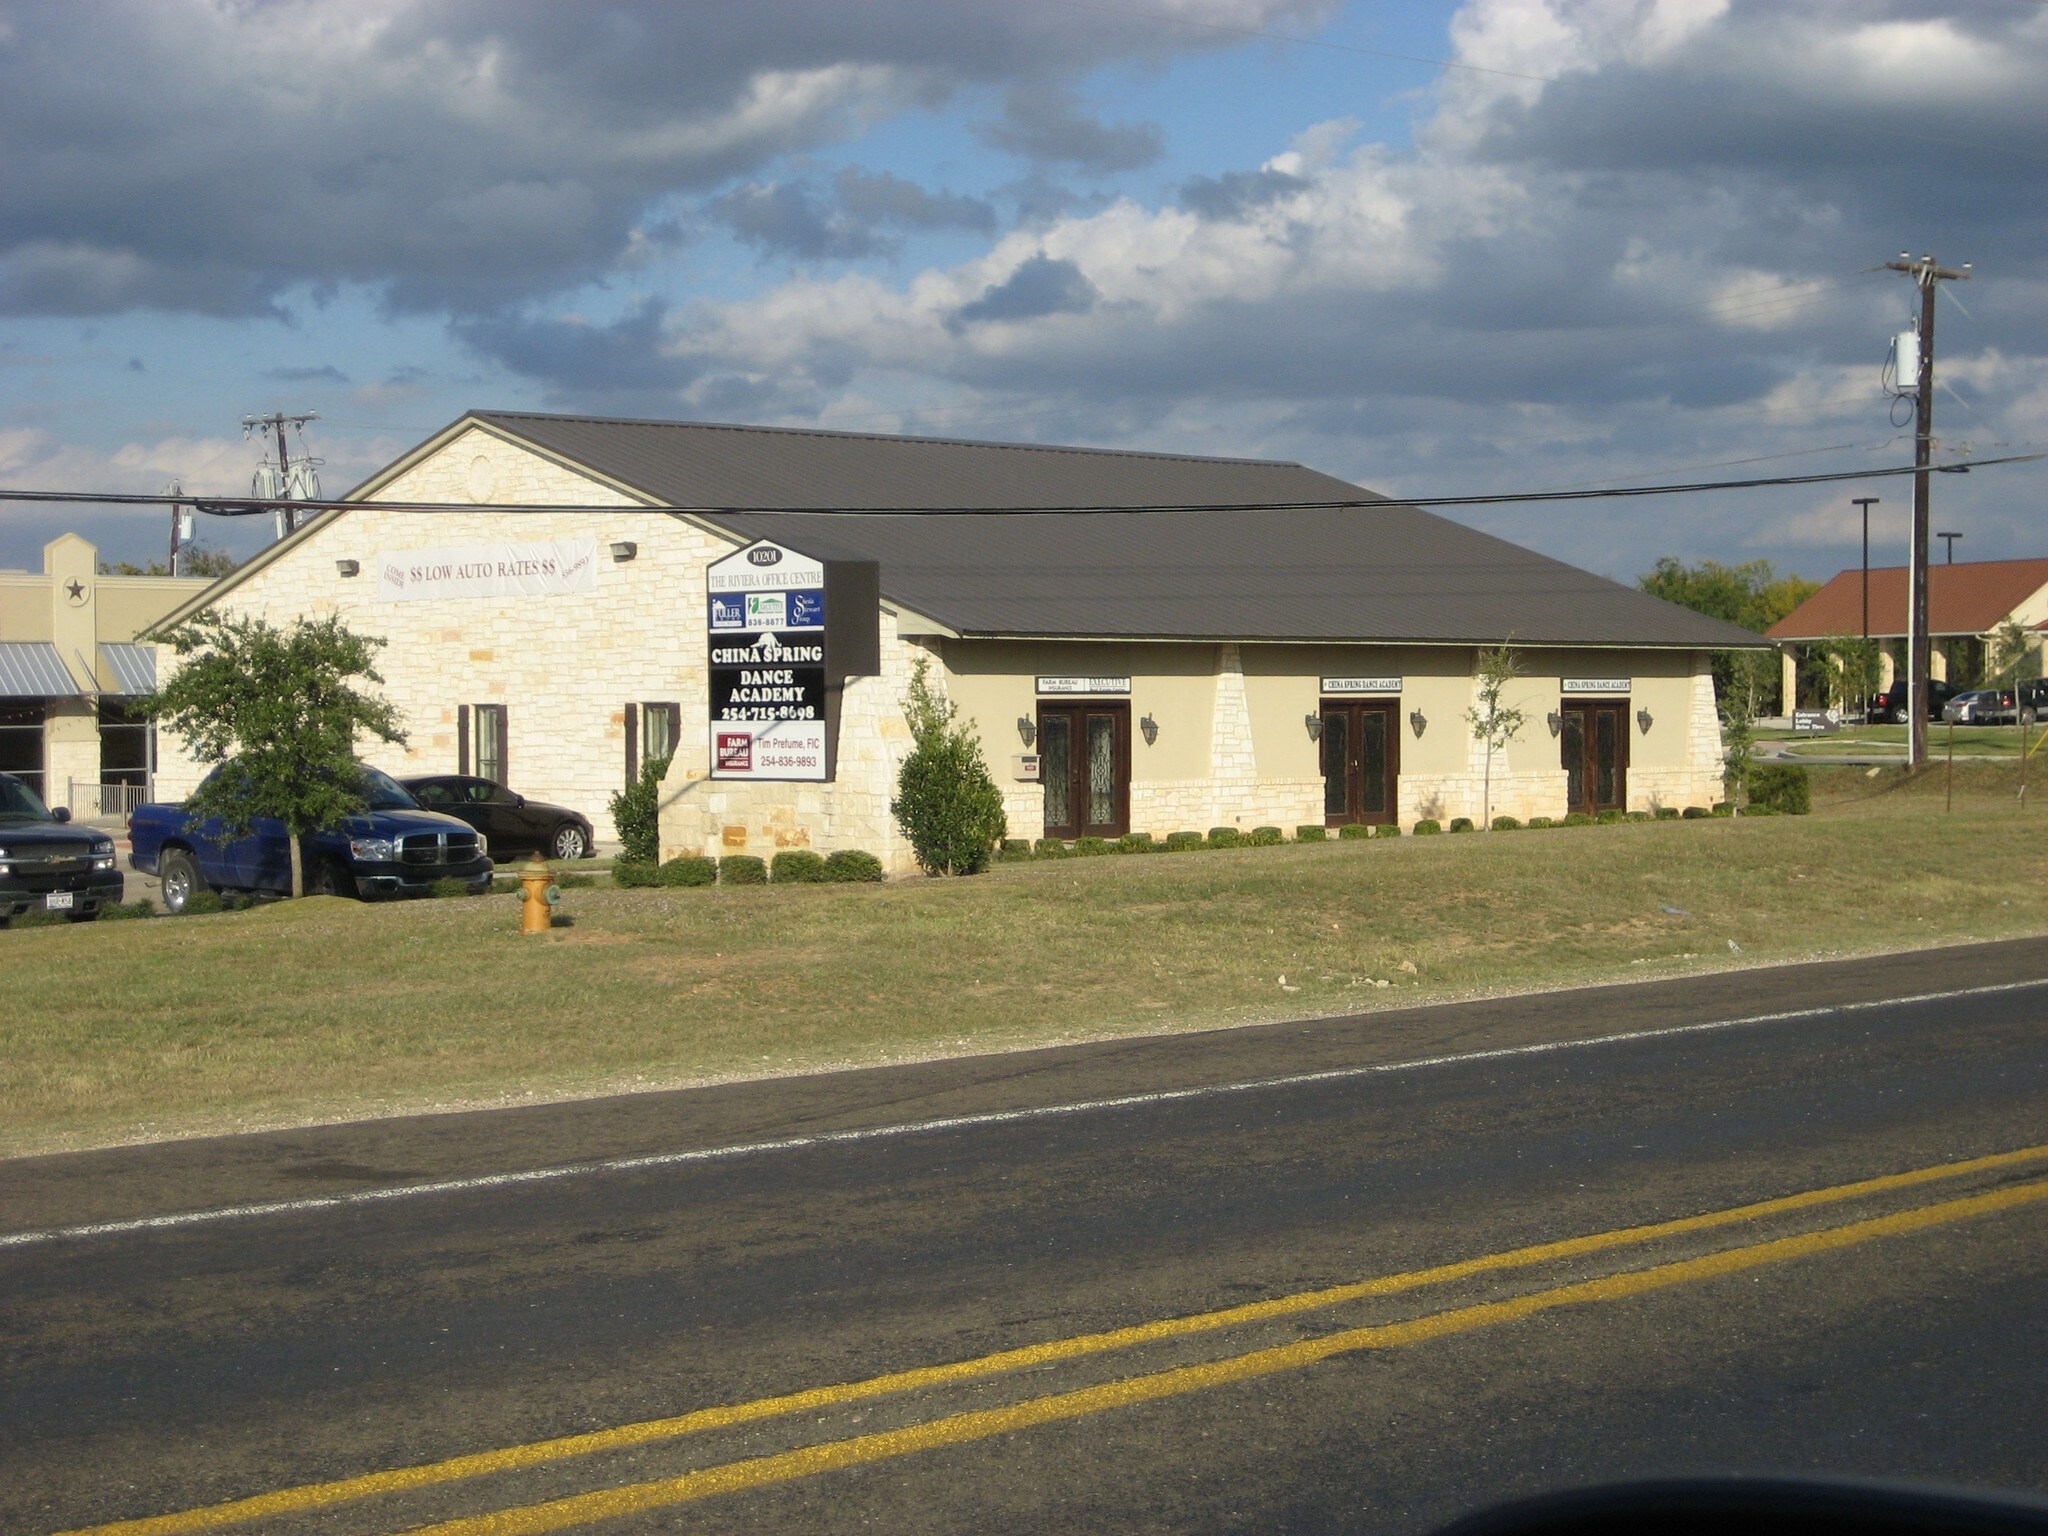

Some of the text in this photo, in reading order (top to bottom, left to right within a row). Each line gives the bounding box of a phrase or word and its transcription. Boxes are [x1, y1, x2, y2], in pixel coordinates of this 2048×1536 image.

[752, 551, 777, 563] 10201
[426, 565, 453, 580] LOW
[456, 562, 493, 579] AUTO
[498, 560, 540, 577] RATES
[711, 570, 822, 588] THE RIVIERA OFFICE CENTRE
[715, 608, 742, 618] FULLER
[712, 646, 822, 663] CHINA SPRING
[740, 669, 794, 685] DANCE
[1089, 678, 1127, 686] EXECUTIVE
[730, 686, 806, 703] ACADEMY
[721, 705, 815, 721] 254-715-8698
[727, 737, 748, 747] FARM
[758, 737, 771, 749] Tim
[807, 738, 820, 749] FIC
[719, 747, 749, 757] BUREAU
[761, 756, 817, 767] 254-836-9893
